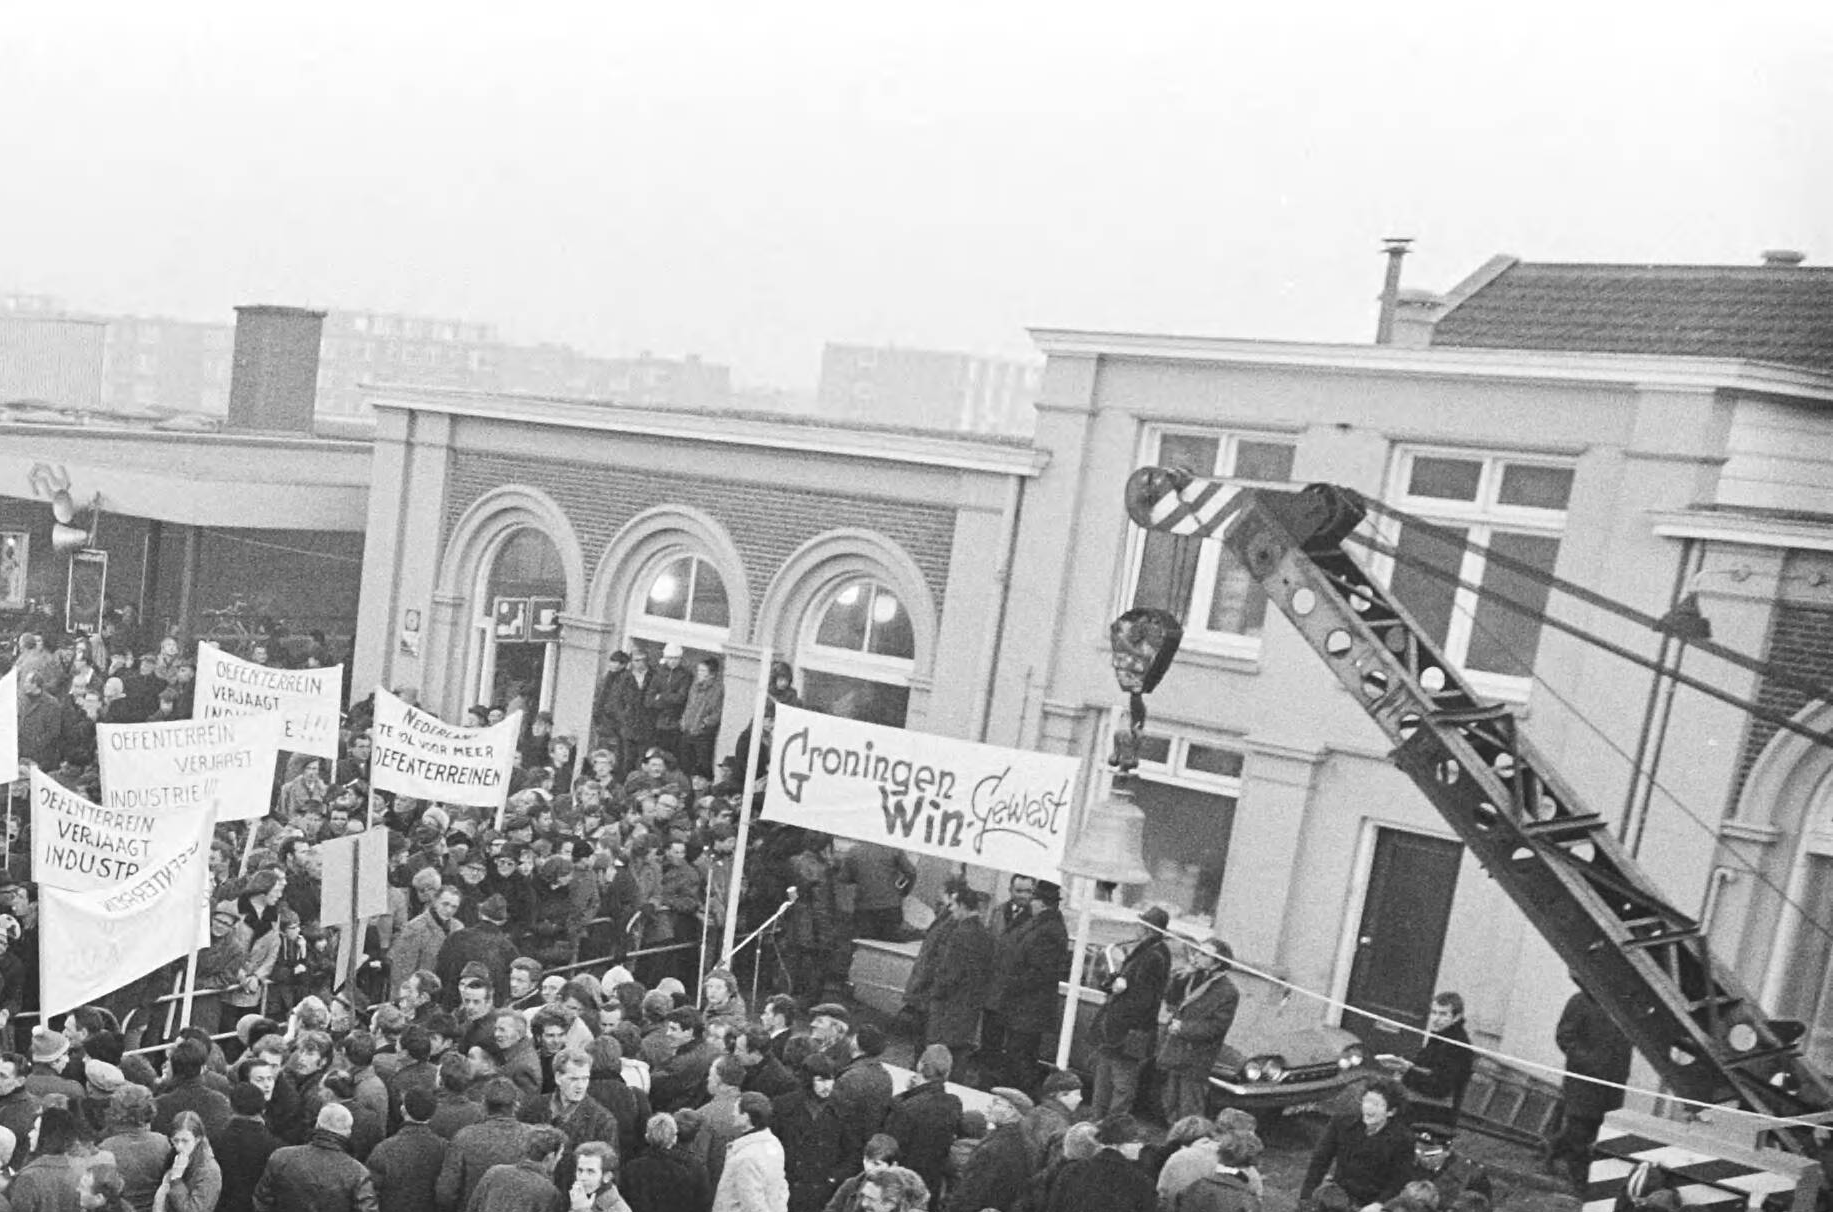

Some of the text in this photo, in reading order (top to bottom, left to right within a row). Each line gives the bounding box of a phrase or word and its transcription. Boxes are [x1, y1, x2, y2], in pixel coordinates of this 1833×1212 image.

[215, 660, 322, 696] OEFENTERREIN
[211, 684, 280, 712] VERJAAGT
[110, 723, 236, 751] OEFENTERREIN
[779, 727, 956, 803] Groningen
[39, 788, 155, 834] OEFENTERREIN
[57, 820, 152, 858] VERJAAGT
